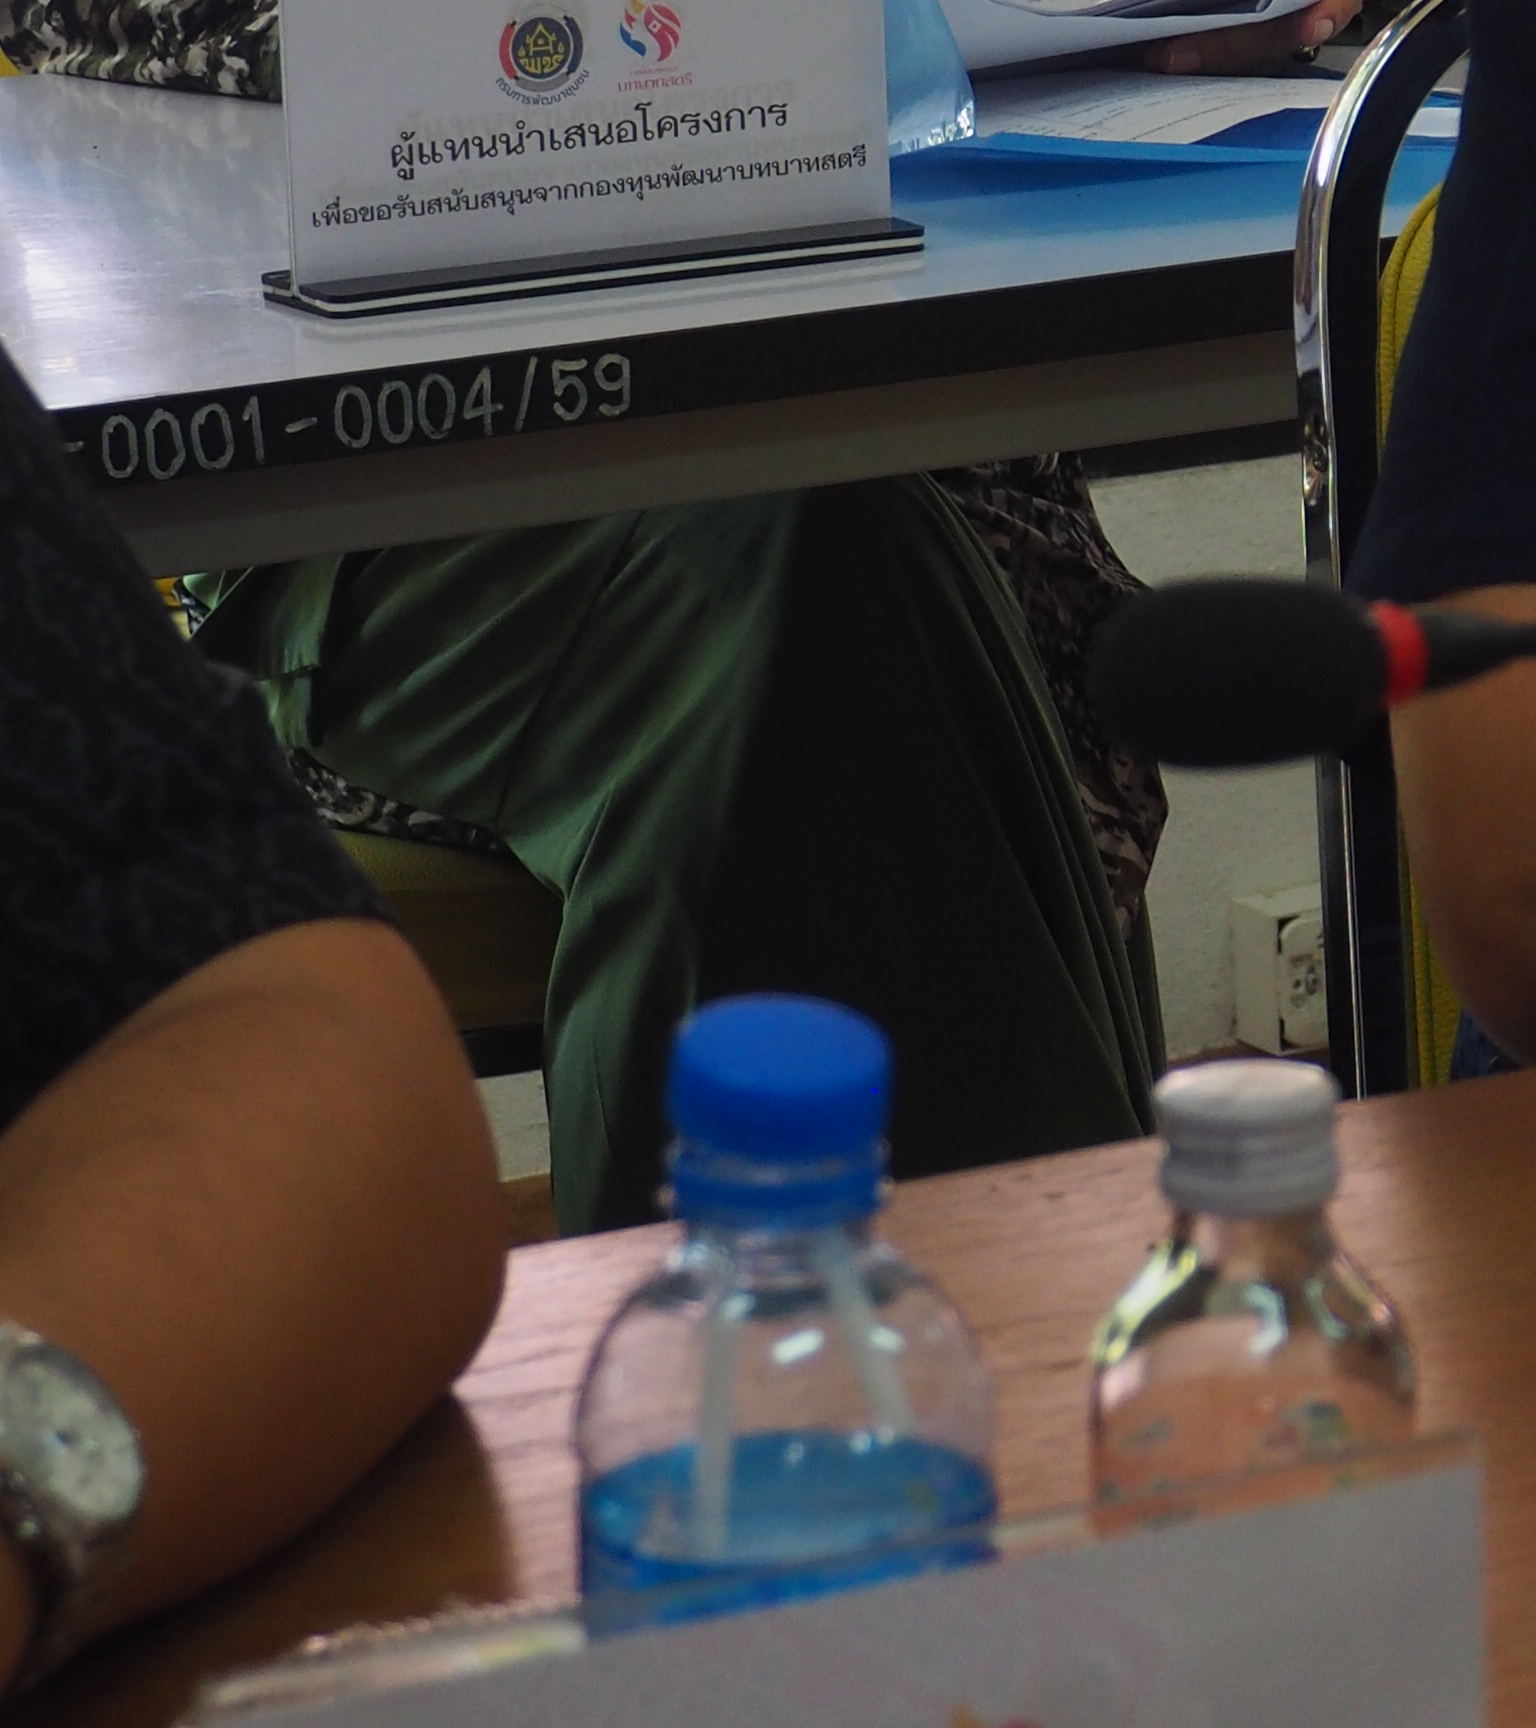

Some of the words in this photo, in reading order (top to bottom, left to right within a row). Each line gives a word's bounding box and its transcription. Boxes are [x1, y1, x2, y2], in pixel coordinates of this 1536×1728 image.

[390, 99, 789, 182] ผู้แทนนำเสนอโครงการ
[311, 146, 868, 231] เพื่อขอรับสนับสนุนจากกองทุนพัฒนาบทบาทสตรี
